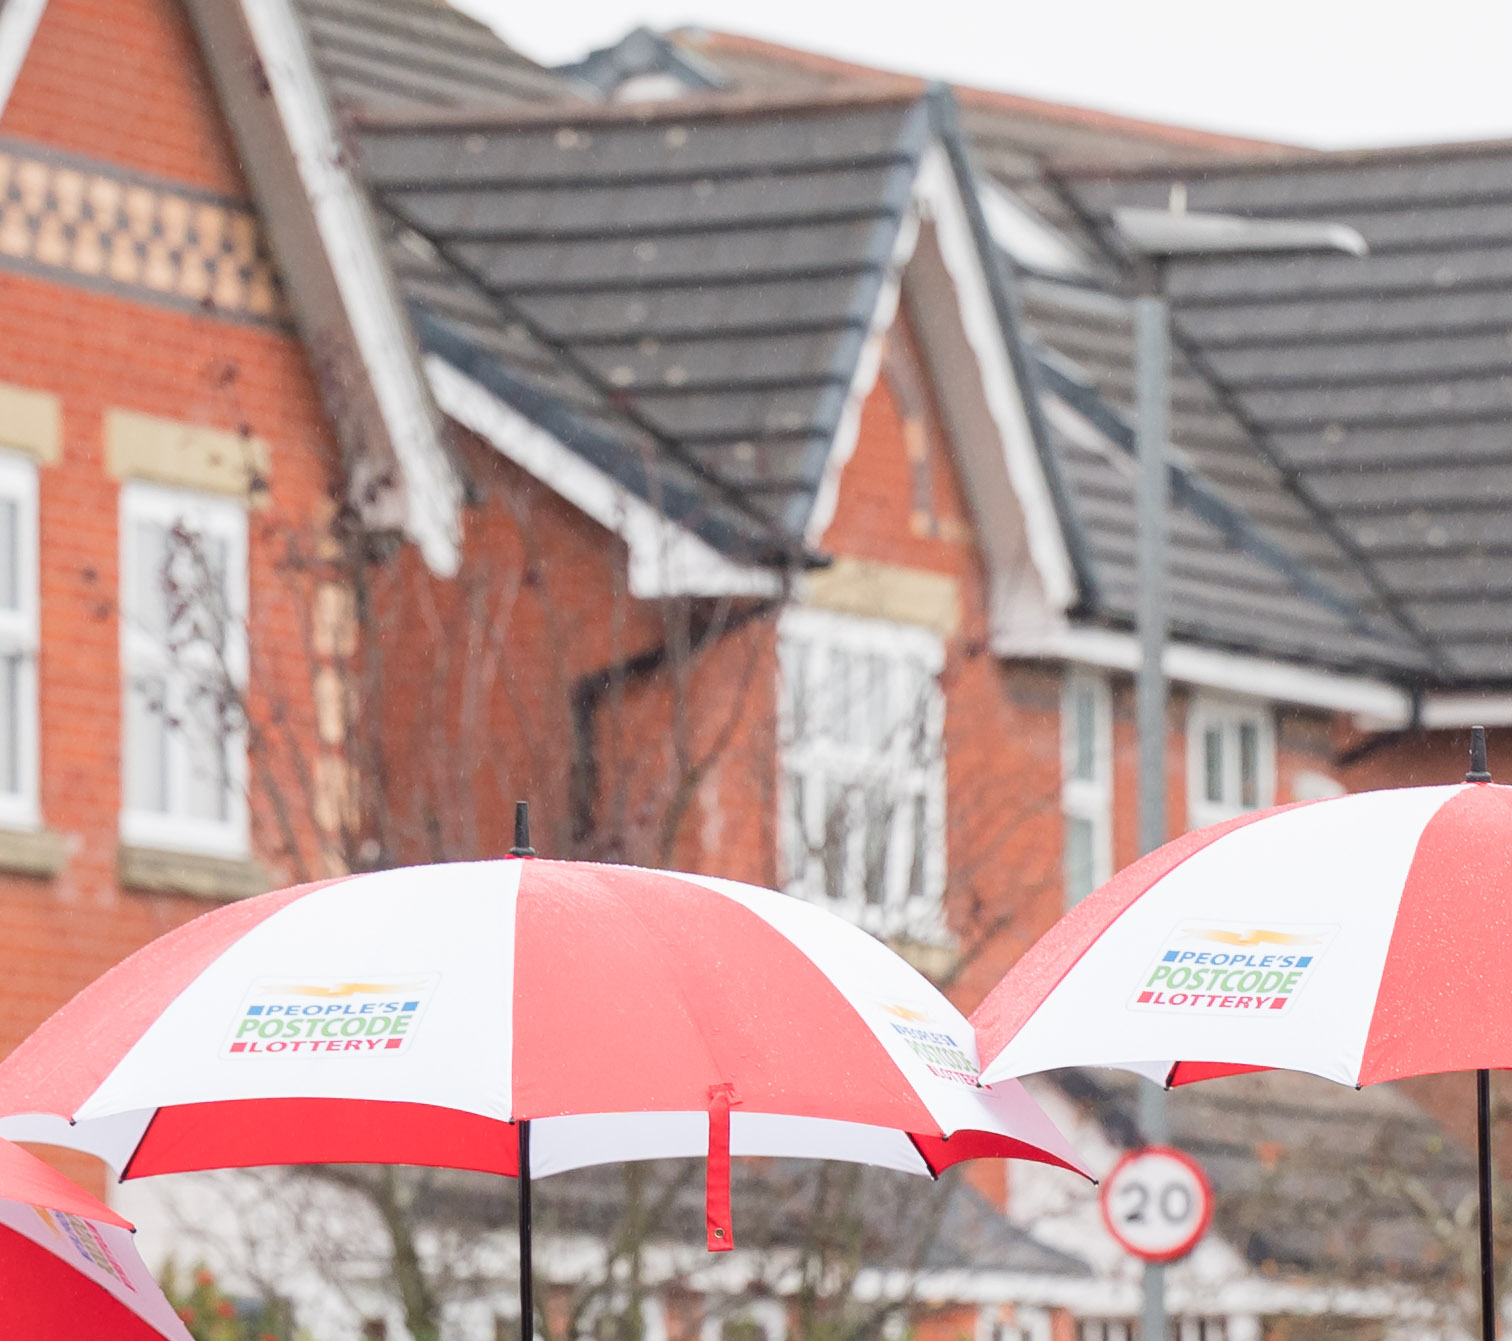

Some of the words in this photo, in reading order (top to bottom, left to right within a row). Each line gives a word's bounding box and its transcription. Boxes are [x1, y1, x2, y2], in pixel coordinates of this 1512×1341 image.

[1179, 952, 1297, 968] PEOPLE'S
[1146, 965, 1303, 994] POSTCODE
[265, 1002, 400, 1015] PEOPLE'S
[1153, 992, 1272, 1009] LOTTERY
[236, 1015, 412, 1038] POSTCODE
[249, 1039, 384, 1052] LOTTERY
[1122, 1182, 1190, 1224] 20
